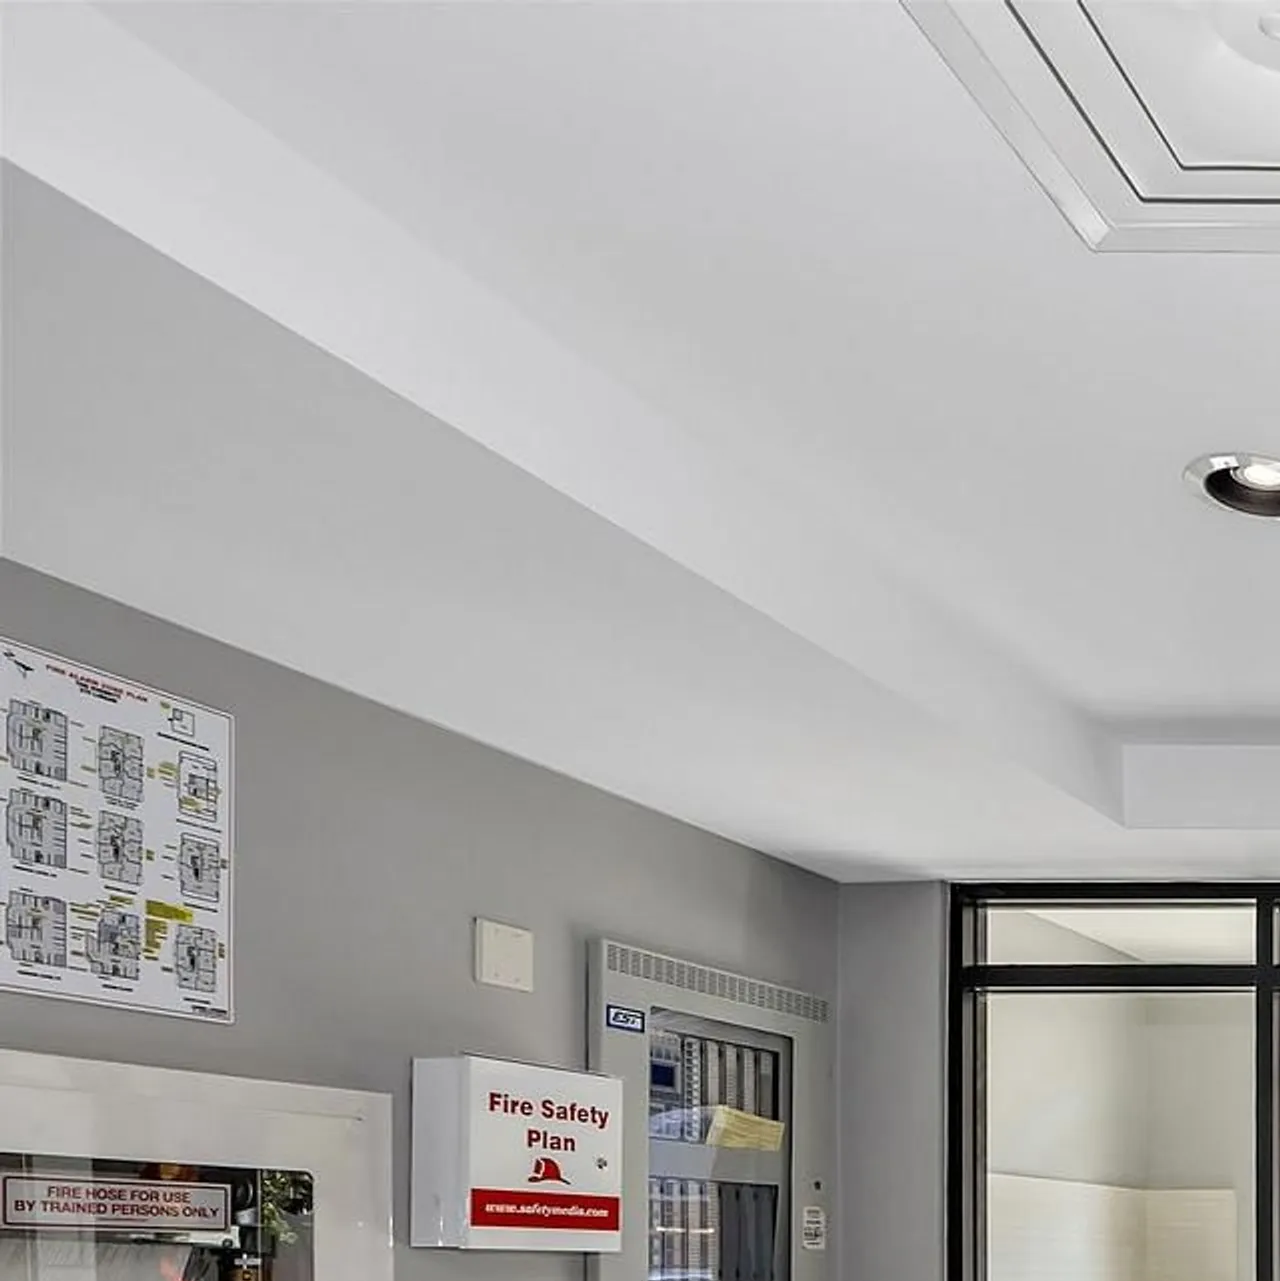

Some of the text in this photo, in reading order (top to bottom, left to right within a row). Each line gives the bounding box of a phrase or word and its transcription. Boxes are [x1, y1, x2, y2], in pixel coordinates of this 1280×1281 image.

[489, 1092, 609, 1130] Fire Safety
[527, 1129, 576, 1152] Plan
[47, 1185, 192, 1204] FIRE HOSE FOR USE
[14, 1199, 220, 1219] BY TRAINED PERSONS ONLY
[485, 1202, 610, 1218] www.safetymedia.com
